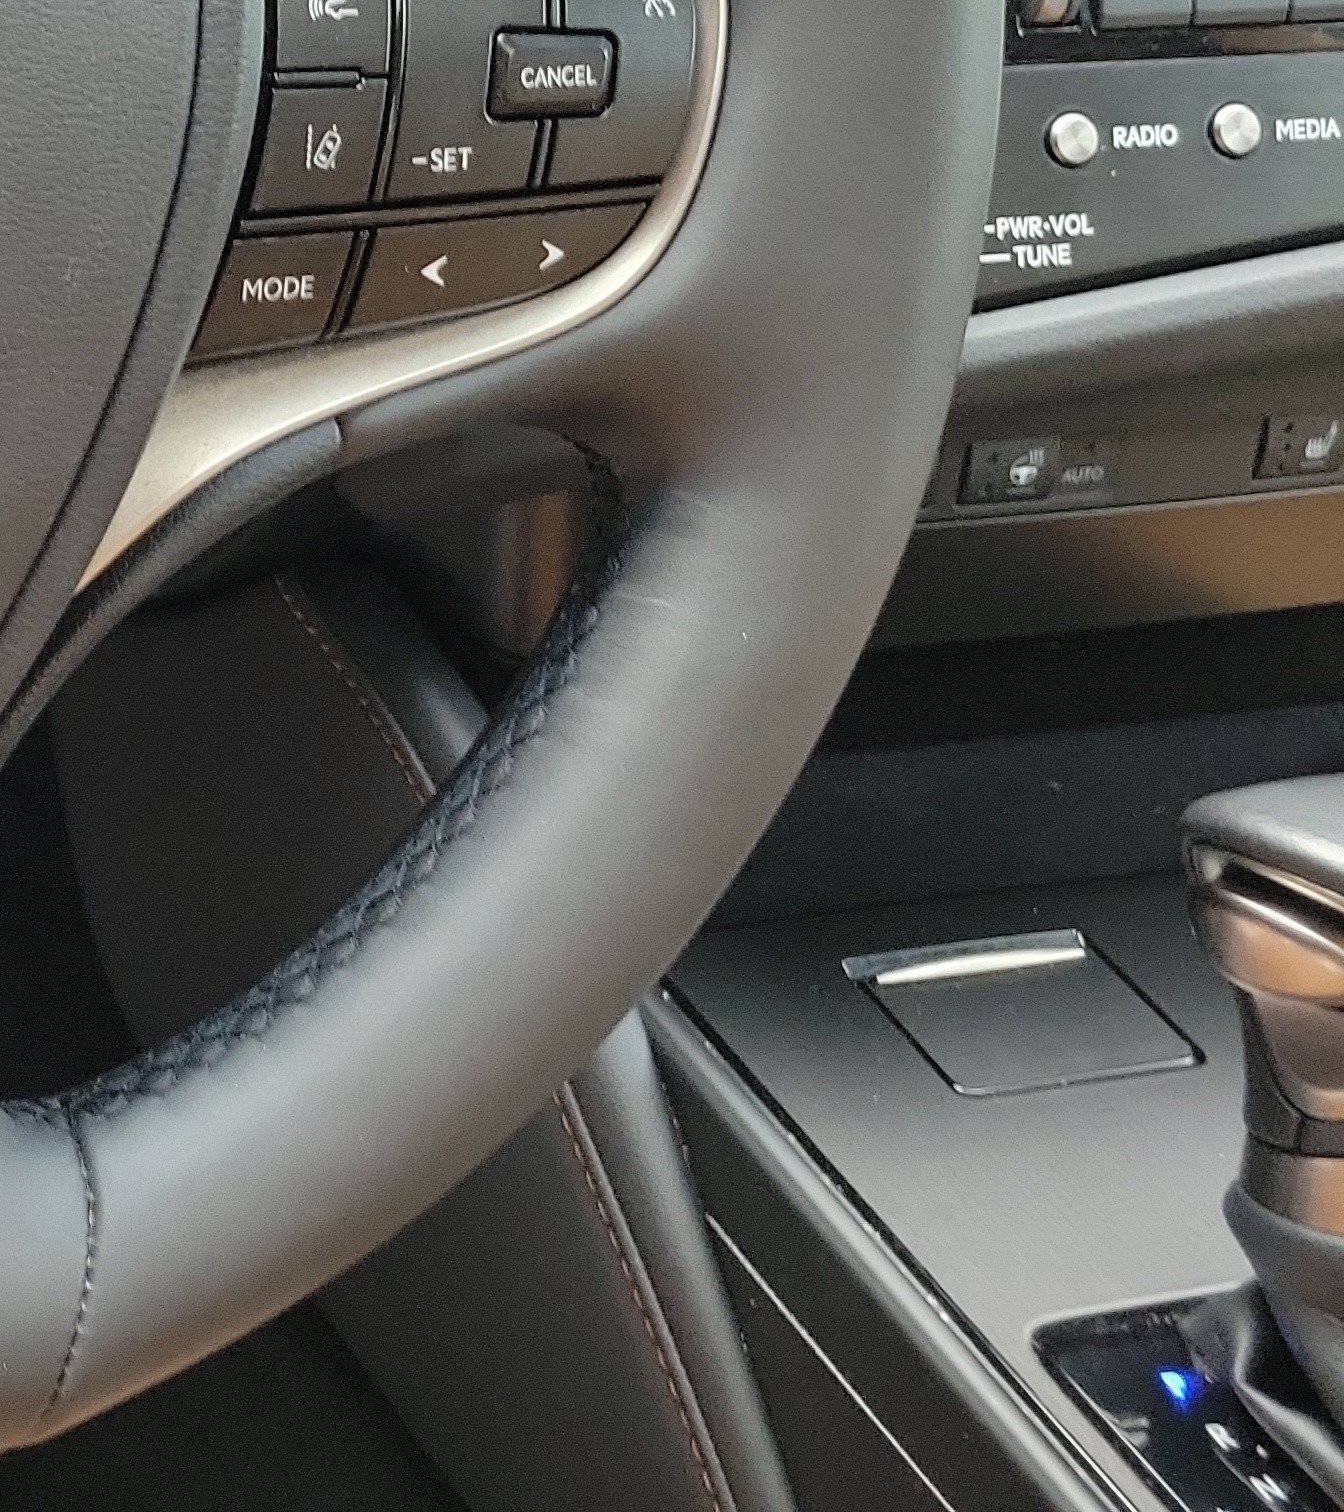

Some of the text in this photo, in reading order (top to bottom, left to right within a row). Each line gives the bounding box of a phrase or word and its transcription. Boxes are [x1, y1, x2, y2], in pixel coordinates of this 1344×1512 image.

[520, 64, 597, 88] CANCEL
[1112, 124, 1179, 149] RADIO
[1274, 117, 1341, 142] MEDIA
[1012, 242, 1073, 269] TUNE
[241, 274, 315, 303] MODE
[1062, 464, 1105, 485] AUTO
